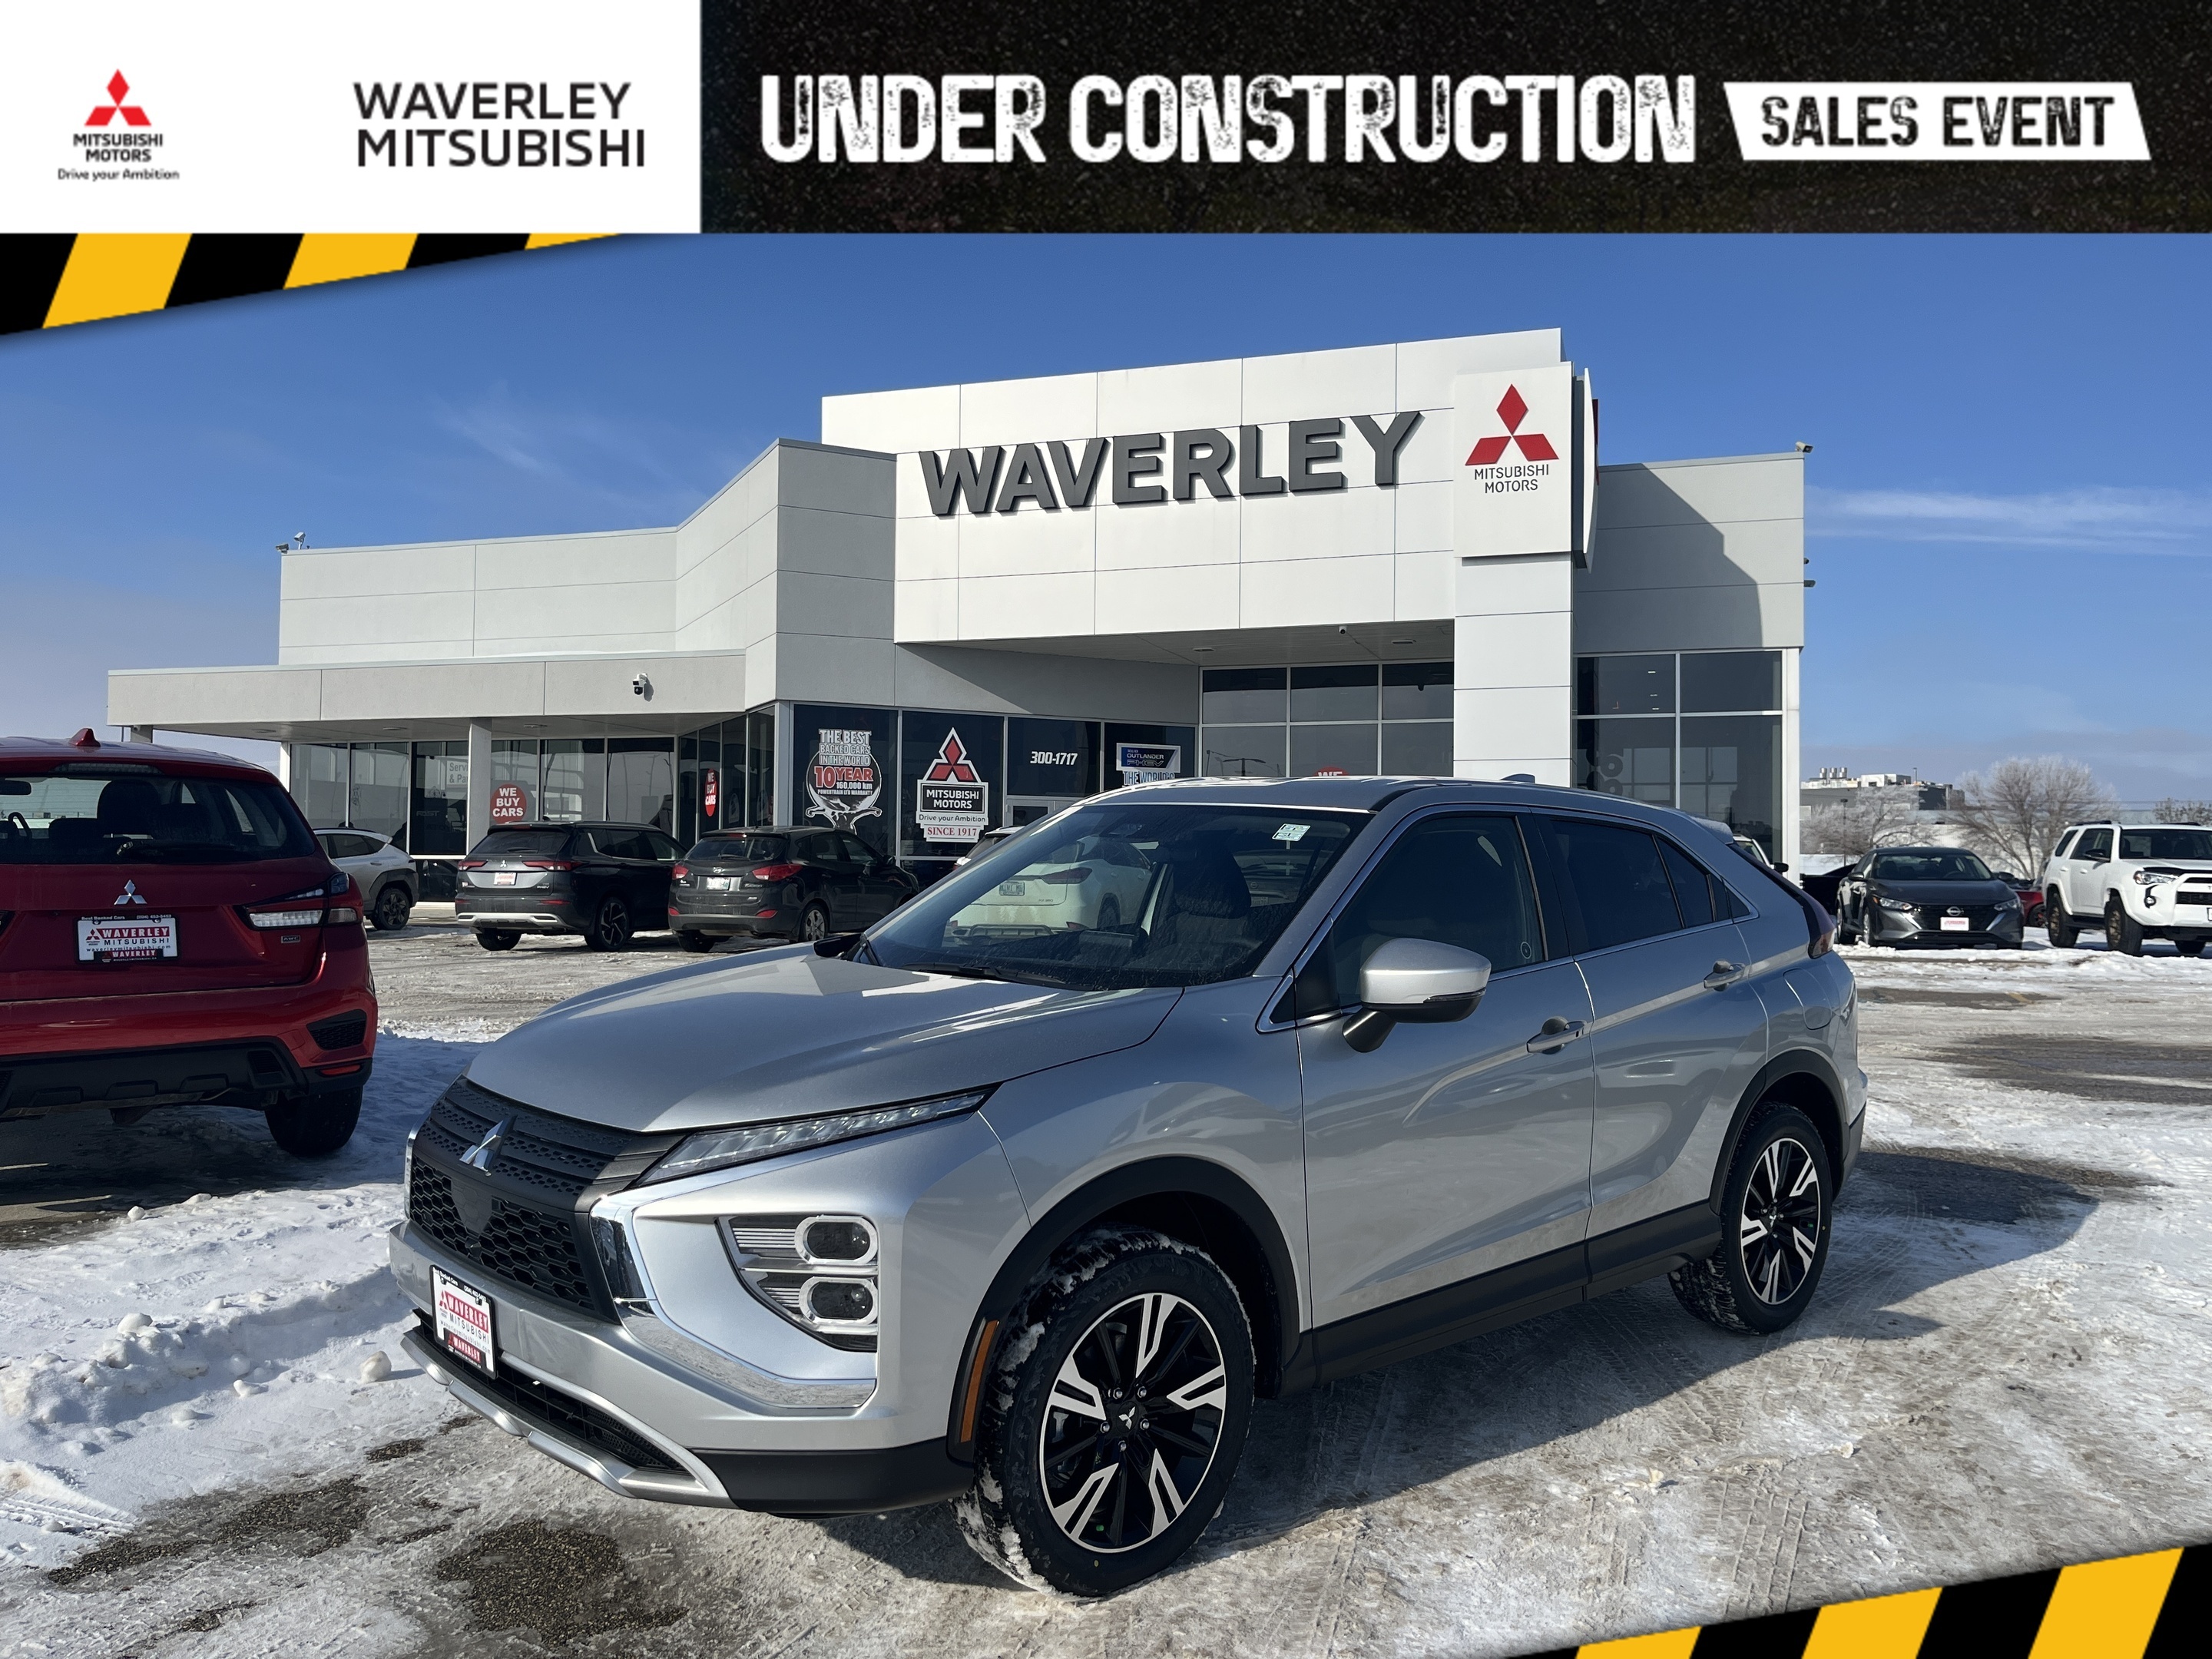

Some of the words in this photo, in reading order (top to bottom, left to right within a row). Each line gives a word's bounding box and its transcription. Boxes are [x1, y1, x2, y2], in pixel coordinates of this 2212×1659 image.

[918, 411, 1424, 517] WAVERLEY
[1474, 464, 1548, 480] MITSUBISHI
[1485, 479, 1538, 494] MOTORS
[819, 730, 841, 743] THE
[843, 730, 871, 744] BEST
[820, 744, 849, 754] BACKED
[850, 745, 870, 755] CARS
[820, 755, 827, 764] IN
[828, 755, 843, 764] THE
[844, 756, 870, 765] WORLD
[1030, 751, 1078, 765] 300-1717
[449, 774, 455, 783] &
[814, 767, 836, 788] 10
[834, 767, 873, 781] YEAR
[1124, 771, 1139, 785] THE
[499, 787, 517, 796] WE
[926, 790, 979, 800] MITSUBISHI
[496, 797, 520, 806] BUY
[933, 800, 972, 809] MOTORS
[492, 807, 524, 817] CARS
[927, 826, 955, 836] SINCE
[102, 927, 168, 938] WAVERLEY
[112, 949, 156, 958] WAVERLEY
[446, 1294, 489, 1333] WAVERLEY
[449, 1312, 490, 1344] MITSUBISHI
[452, 1335, 482, 1363] WAVERLEY
